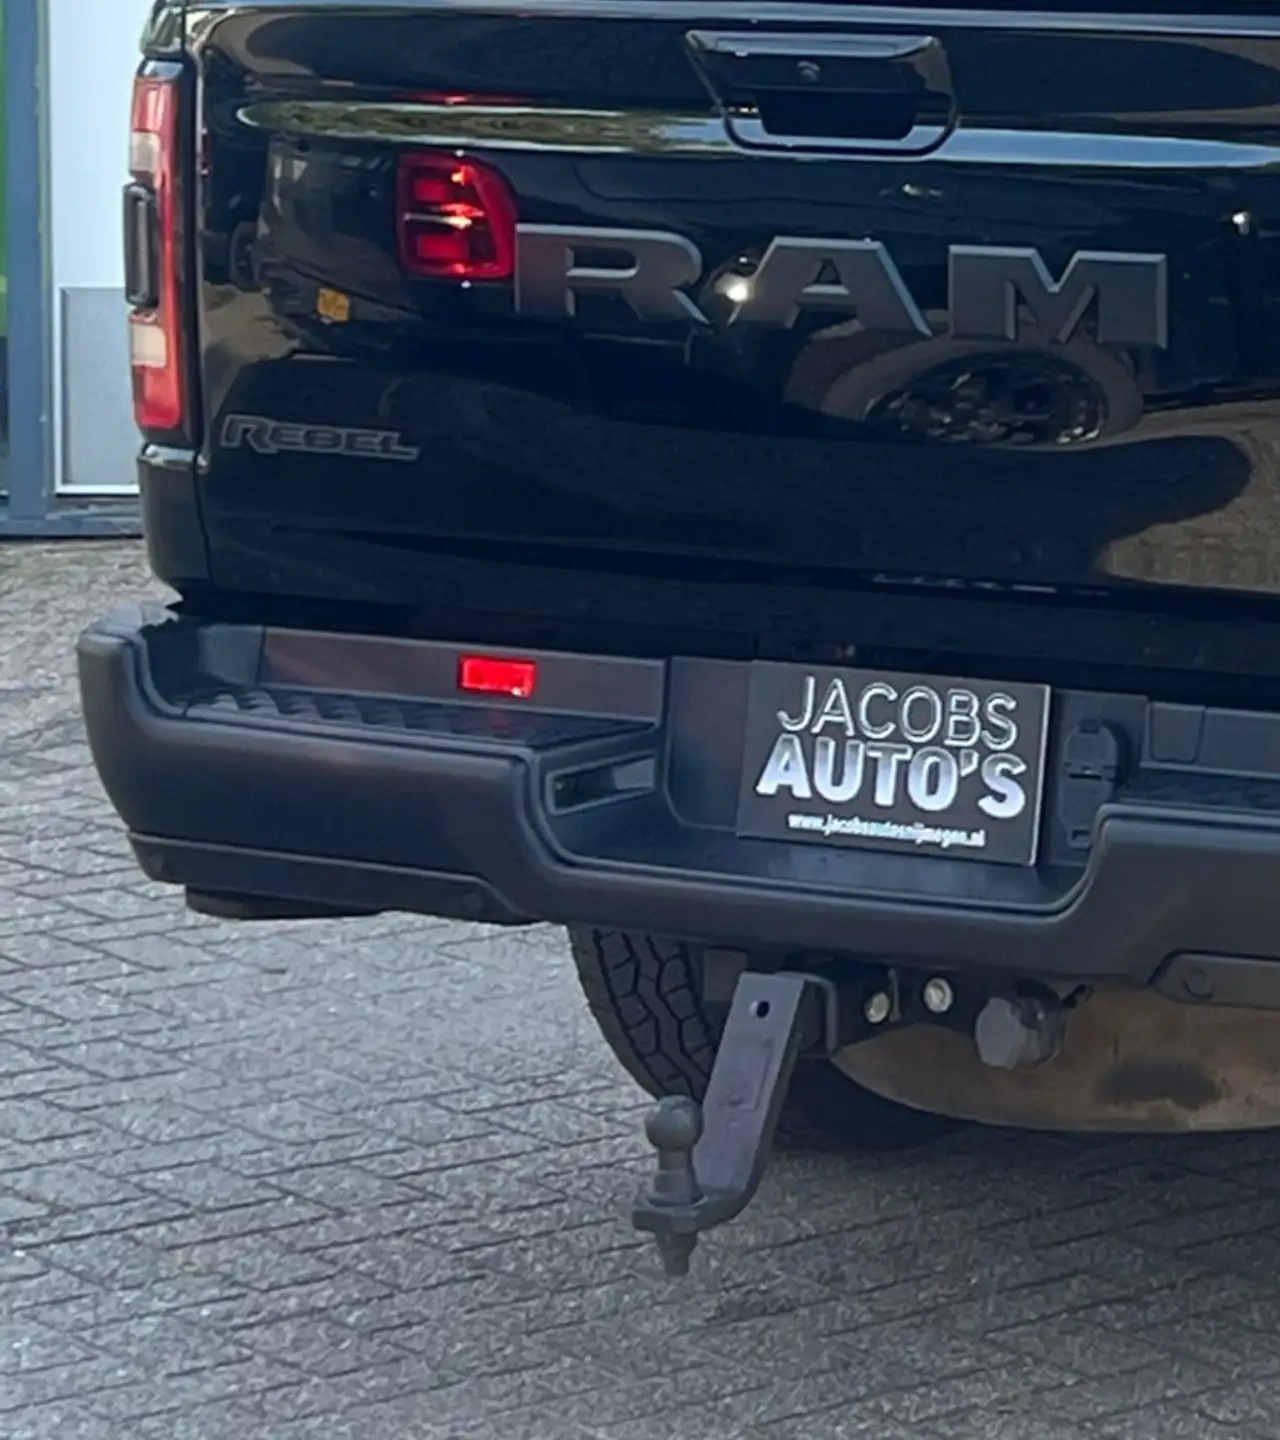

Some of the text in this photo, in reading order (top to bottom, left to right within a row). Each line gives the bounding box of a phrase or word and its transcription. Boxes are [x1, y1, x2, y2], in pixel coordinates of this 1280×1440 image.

[514, 224, 1167, 349] RAM
[220, 414, 420, 461] REBEL
[776, 675, 1019, 751] JACOBS
[755, 733, 1028, 819] AUTO'S
